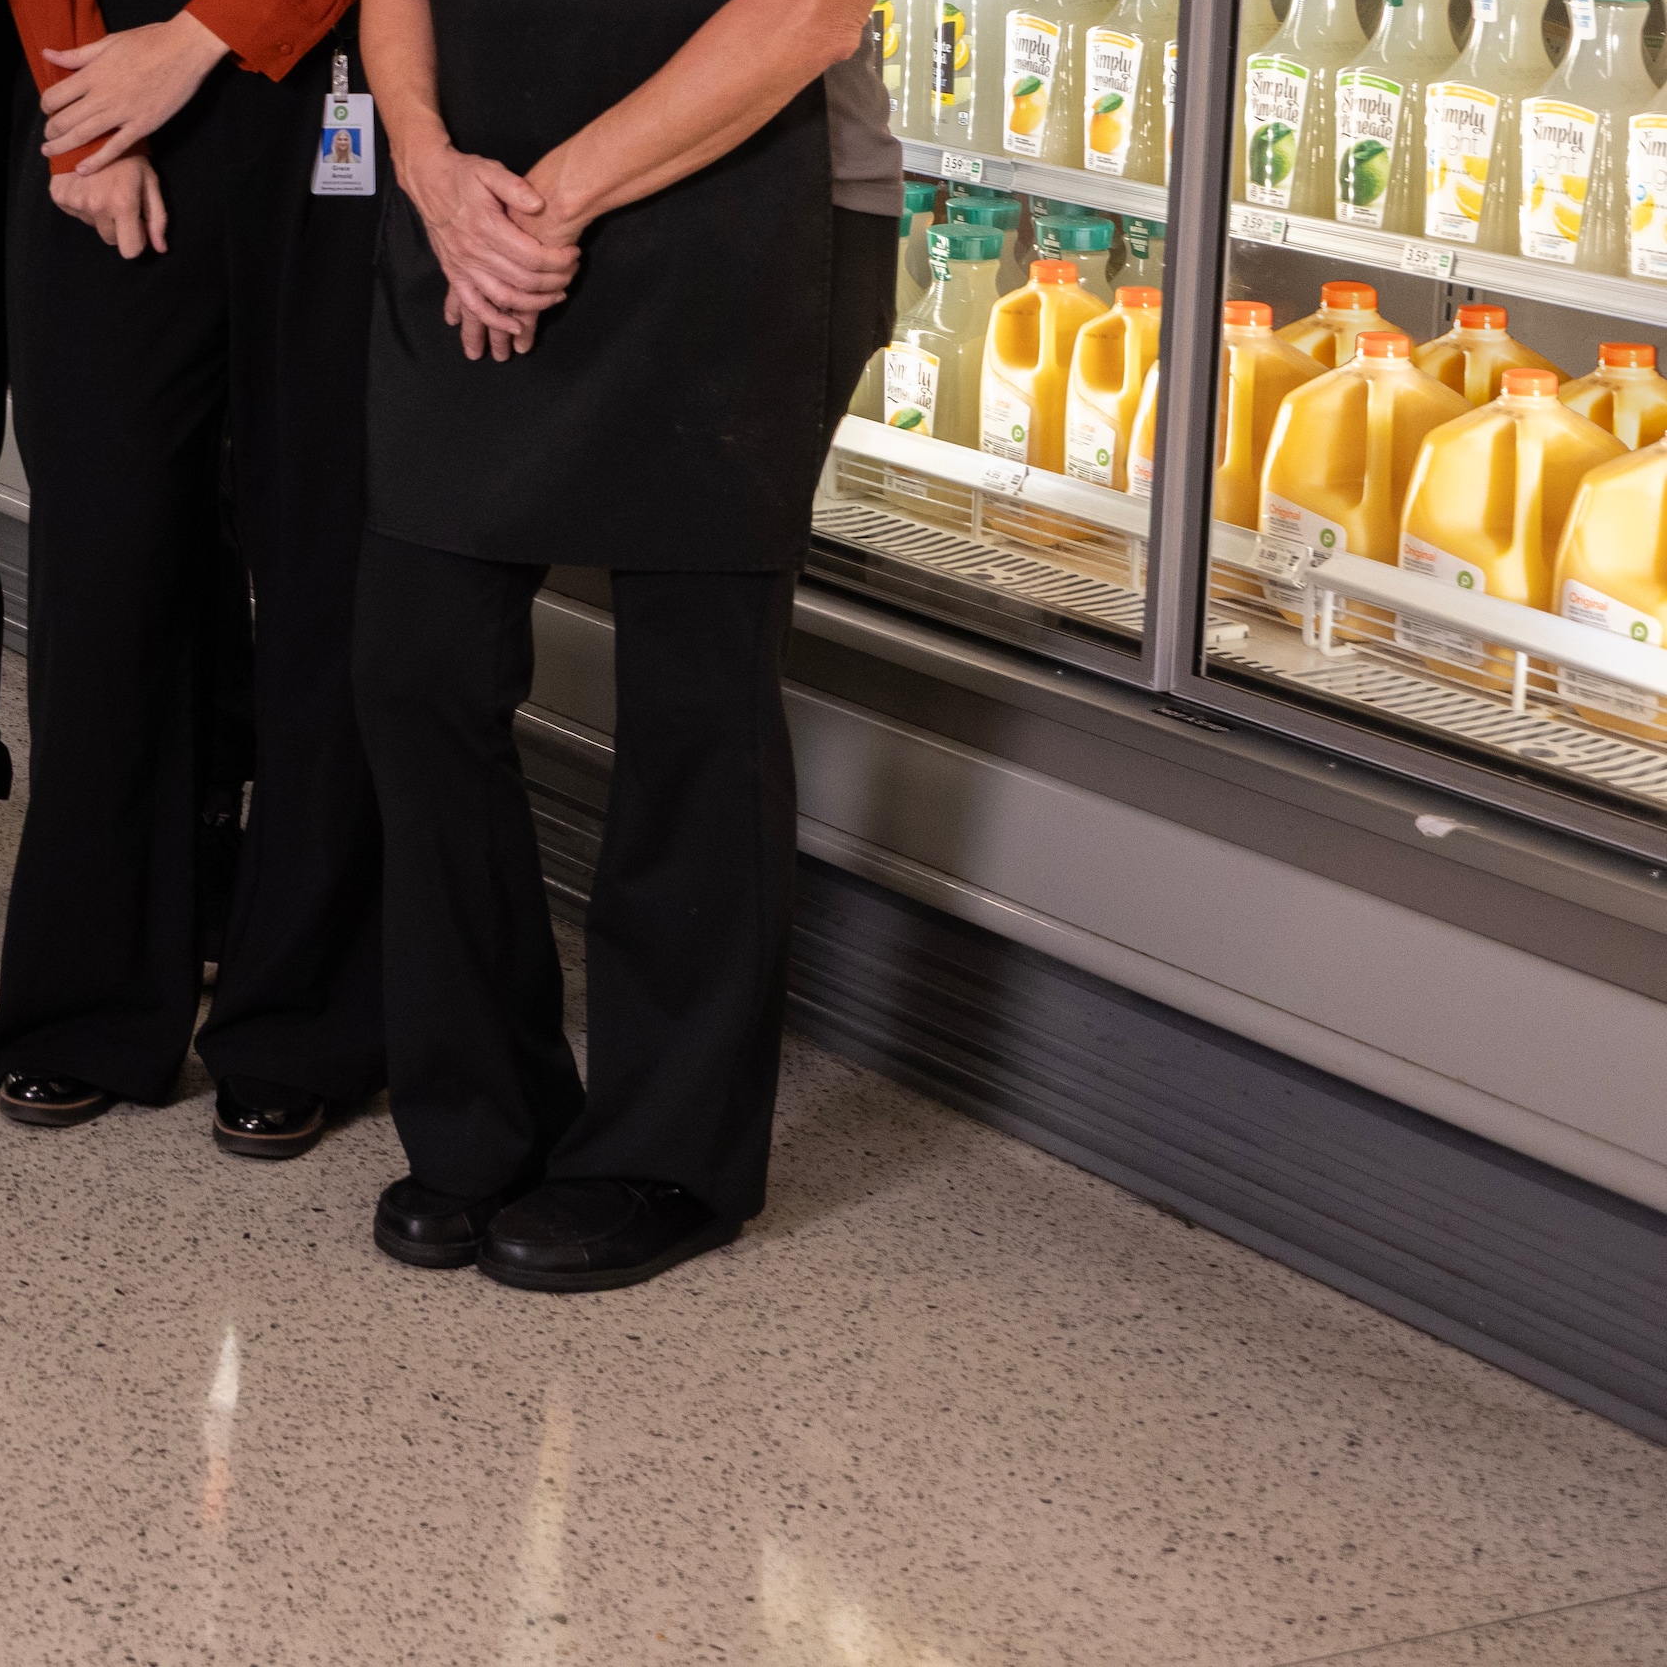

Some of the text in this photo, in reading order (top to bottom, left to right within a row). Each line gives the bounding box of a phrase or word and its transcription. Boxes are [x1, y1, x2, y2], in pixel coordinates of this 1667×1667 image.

[944, 158, 963, 170] 3.59
[1241, 214, 1263, 230] 3.59
[1406, 248, 1429, 264] 3.59
[1269, 503, 1301, 522] Original
[1403, 542, 1437, 563] Original
[1568, 590, 1609, 612] Original
